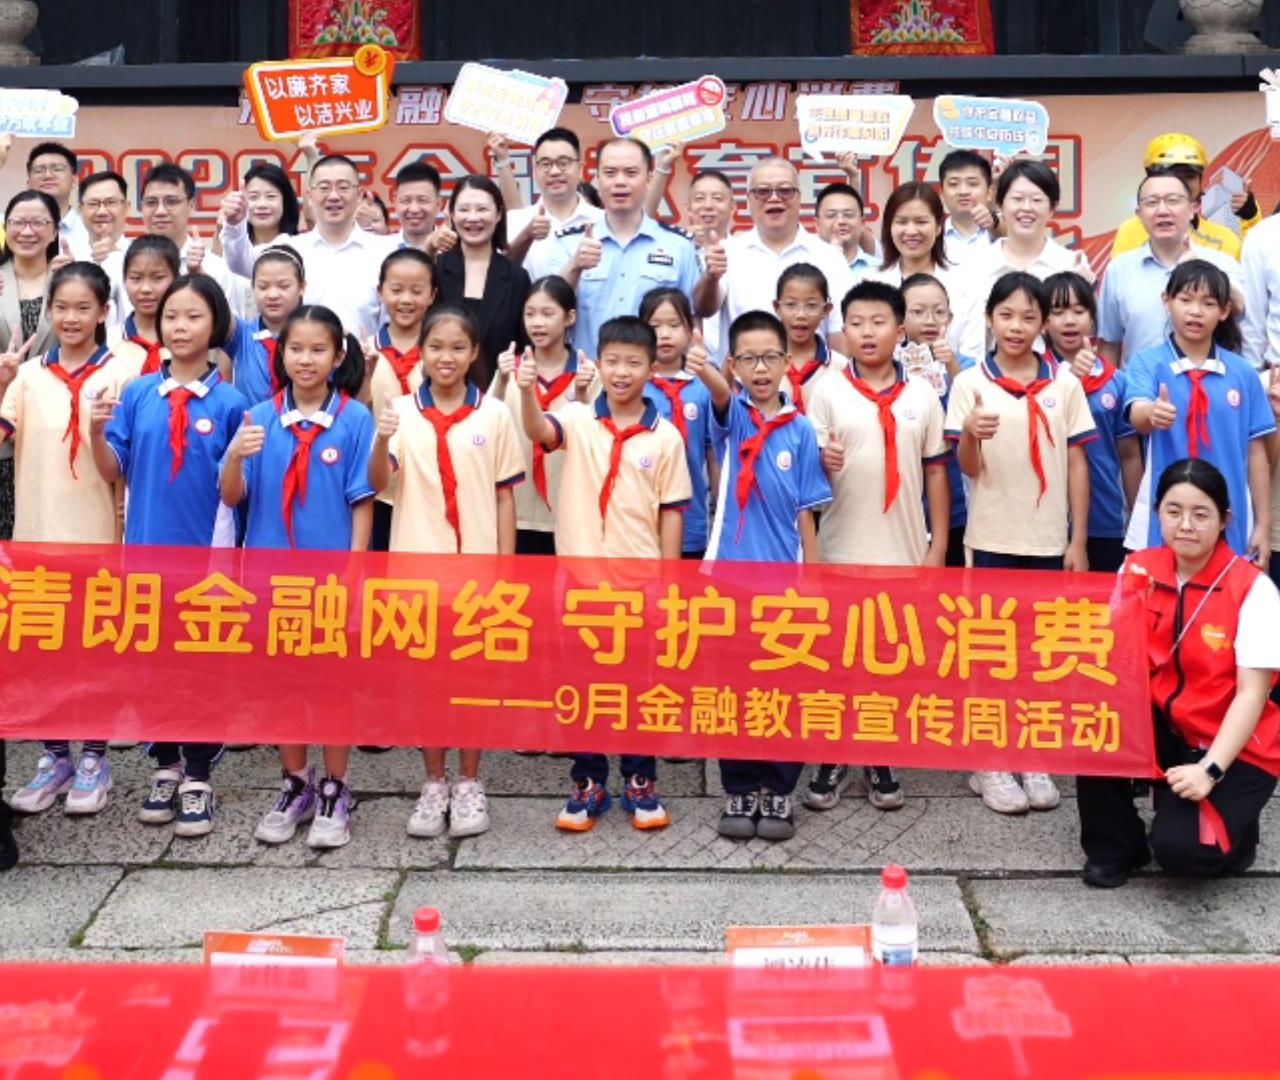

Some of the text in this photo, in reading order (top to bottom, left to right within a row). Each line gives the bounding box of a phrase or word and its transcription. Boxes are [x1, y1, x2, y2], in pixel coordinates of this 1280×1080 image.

[264, 73, 352, 100] 以廉齐家
[293, 98, 374, 127] 以洁兴业
[561, 580, 1118, 686] 守护安心消费
